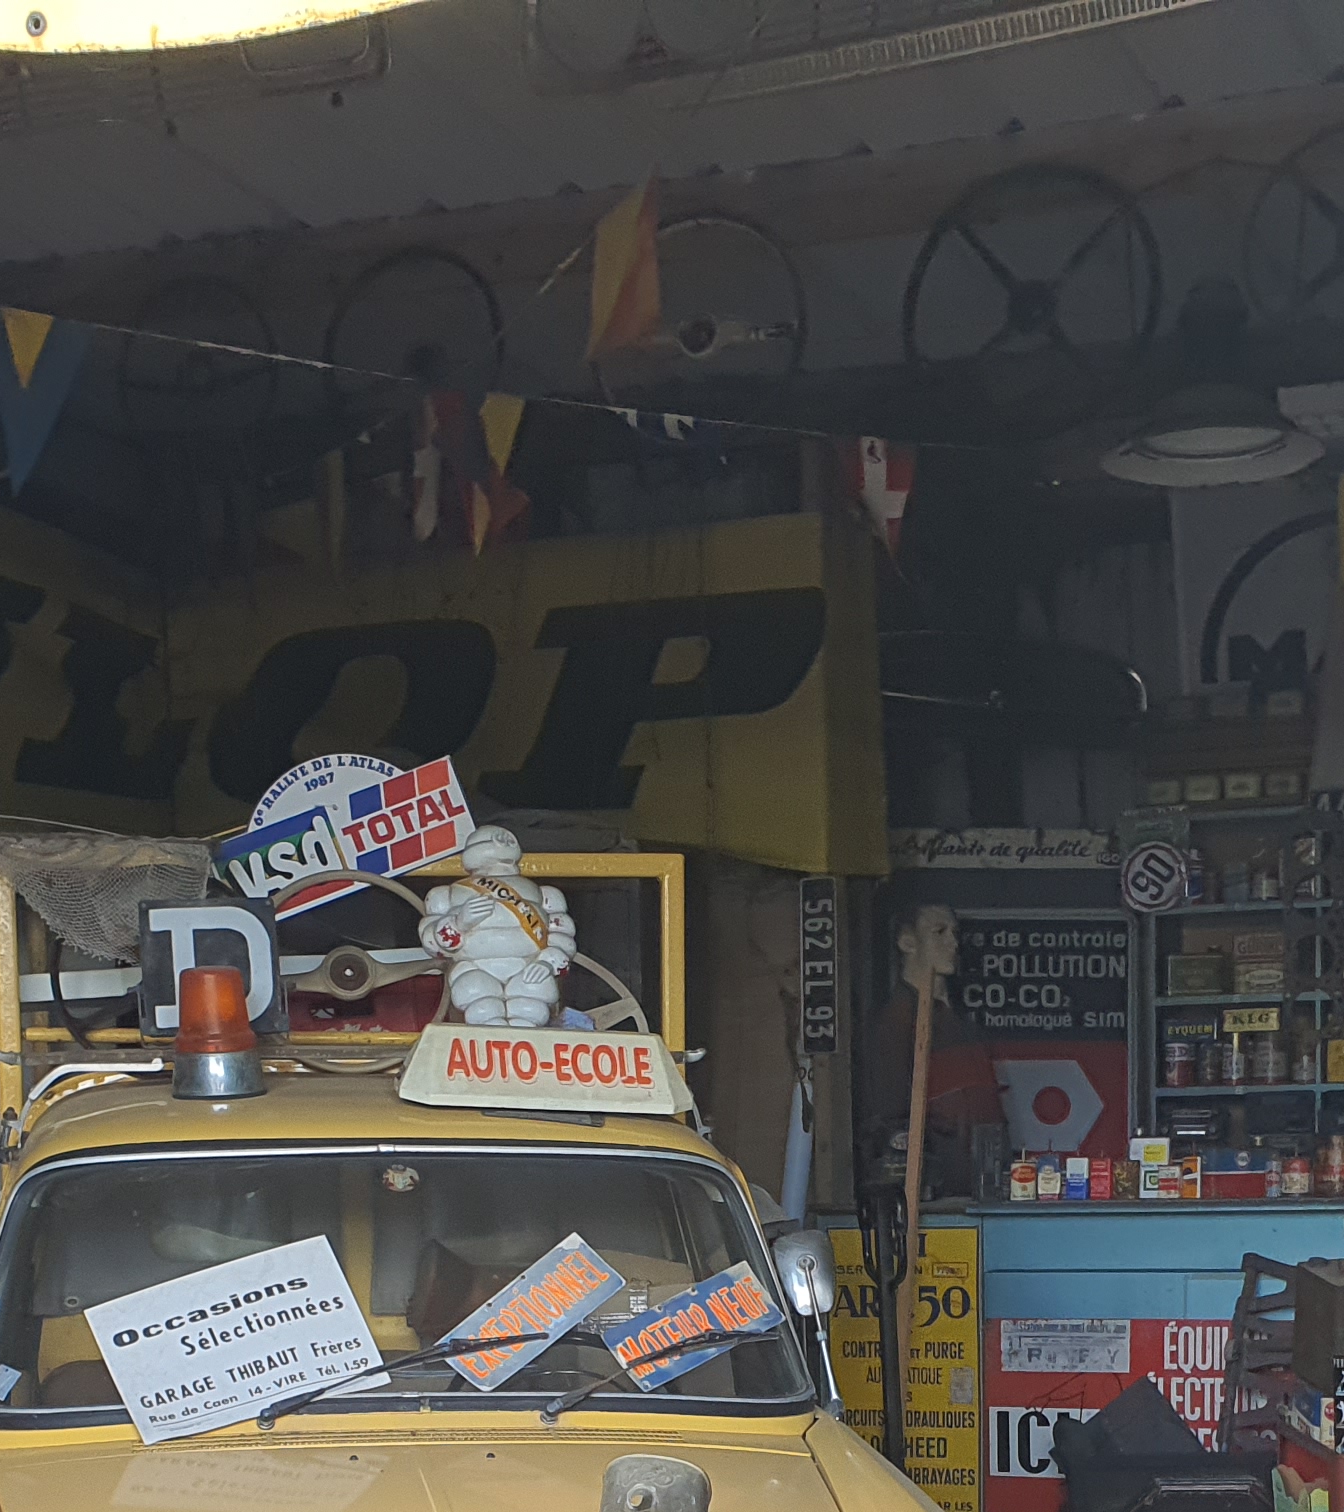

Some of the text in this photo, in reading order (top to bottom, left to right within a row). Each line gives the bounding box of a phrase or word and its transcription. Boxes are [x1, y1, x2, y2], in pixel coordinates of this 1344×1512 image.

[262, 763, 310, 814] RALLYE
[311, 756, 332, 772] DE
[336, 753, 395, 777] L'ATLAS
[303, 771, 336, 793] 1987
[342, 790, 467, 853] TOTAL
[1130, 851, 1176, 900] 90
[476, 876, 545, 944] MICHELIN
[803, 897, 834, 1042] 562 EL 93
[1233, 1012, 1269, 1026] KLG
[447, 1038, 655, 1087] AUTO-ECOLE
[112, 1276, 309, 1348] Occasions
[180, 1296, 344, 1356] Sélectionnées
[706, 1276, 770, 1331] NEUF
[918, 1286, 971, 1328] 50
[140, 1336, 362, 1409] GARAGE THIBAUT Frères
[924, 1341, 964, 1359] PURGE
[149, 1412, 176, 1424] Rue
[181, 1405, 199, 1417] de
[843, 1409, 975, 1428] IRCUITS DRAULIQUES
[954, 1501, 973, 1512] LES
